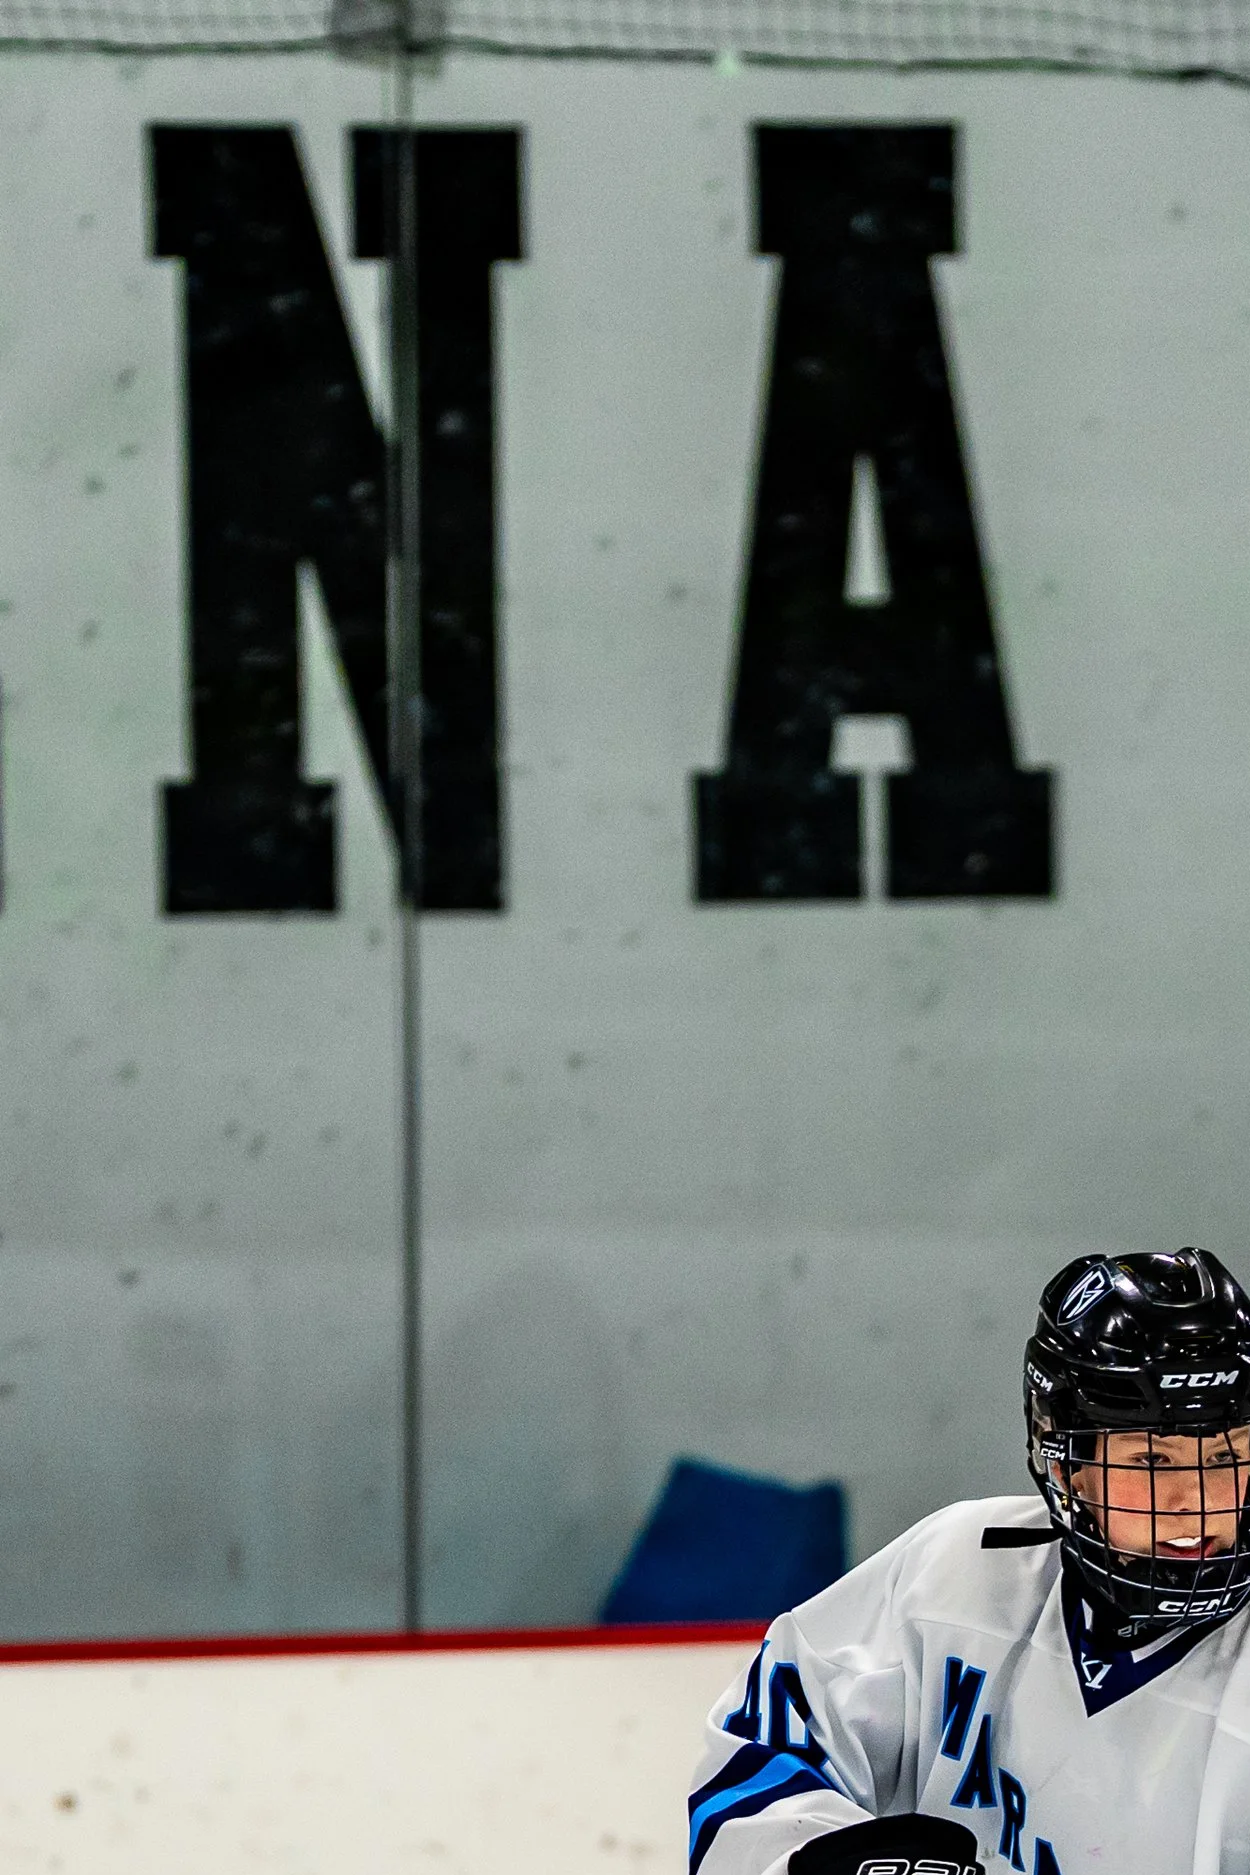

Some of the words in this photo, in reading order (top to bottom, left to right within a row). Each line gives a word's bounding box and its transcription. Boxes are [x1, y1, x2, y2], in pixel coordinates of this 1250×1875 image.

[1027, 1361, 1053, 1392] CCM
[1160, 1370, 1239, 1389] CCM
[1040, 1447, 1065, 1461] CCM
